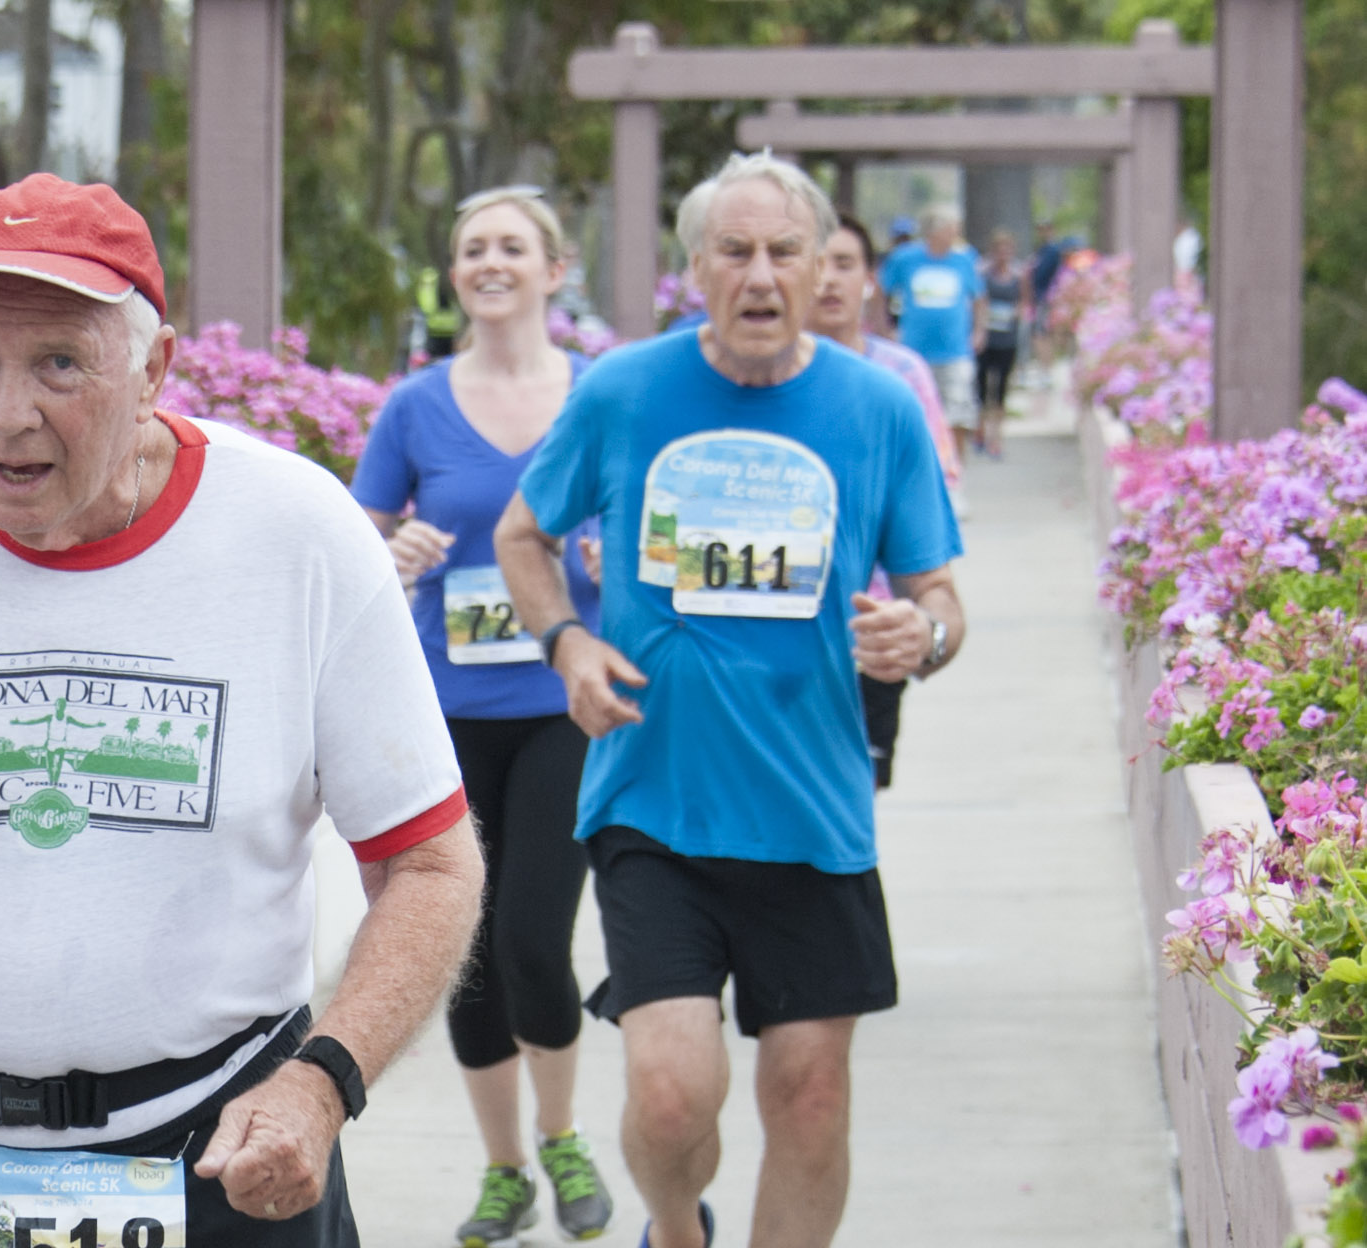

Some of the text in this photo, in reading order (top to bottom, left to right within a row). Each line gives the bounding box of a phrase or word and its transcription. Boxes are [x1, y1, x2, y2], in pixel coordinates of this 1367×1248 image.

[668, 453, 821, 487] Corona Del Mar
[723, 478, 816, 503] Scenic 5K
[703, 542, 790, 591] 611
[69, 655, 154, 671] ANNUAL
[65, 679, 129, 708] DEL
[140, 686, 210, 716] MAR
[87, 780, 157, 812] FIVE
[176, 790, 199, 815] K
[61, 1161, 89, 1176] Del
[92, 1162, 125, 1176] Mar
[41, 1177, 121, 1193] Scenic 5K
